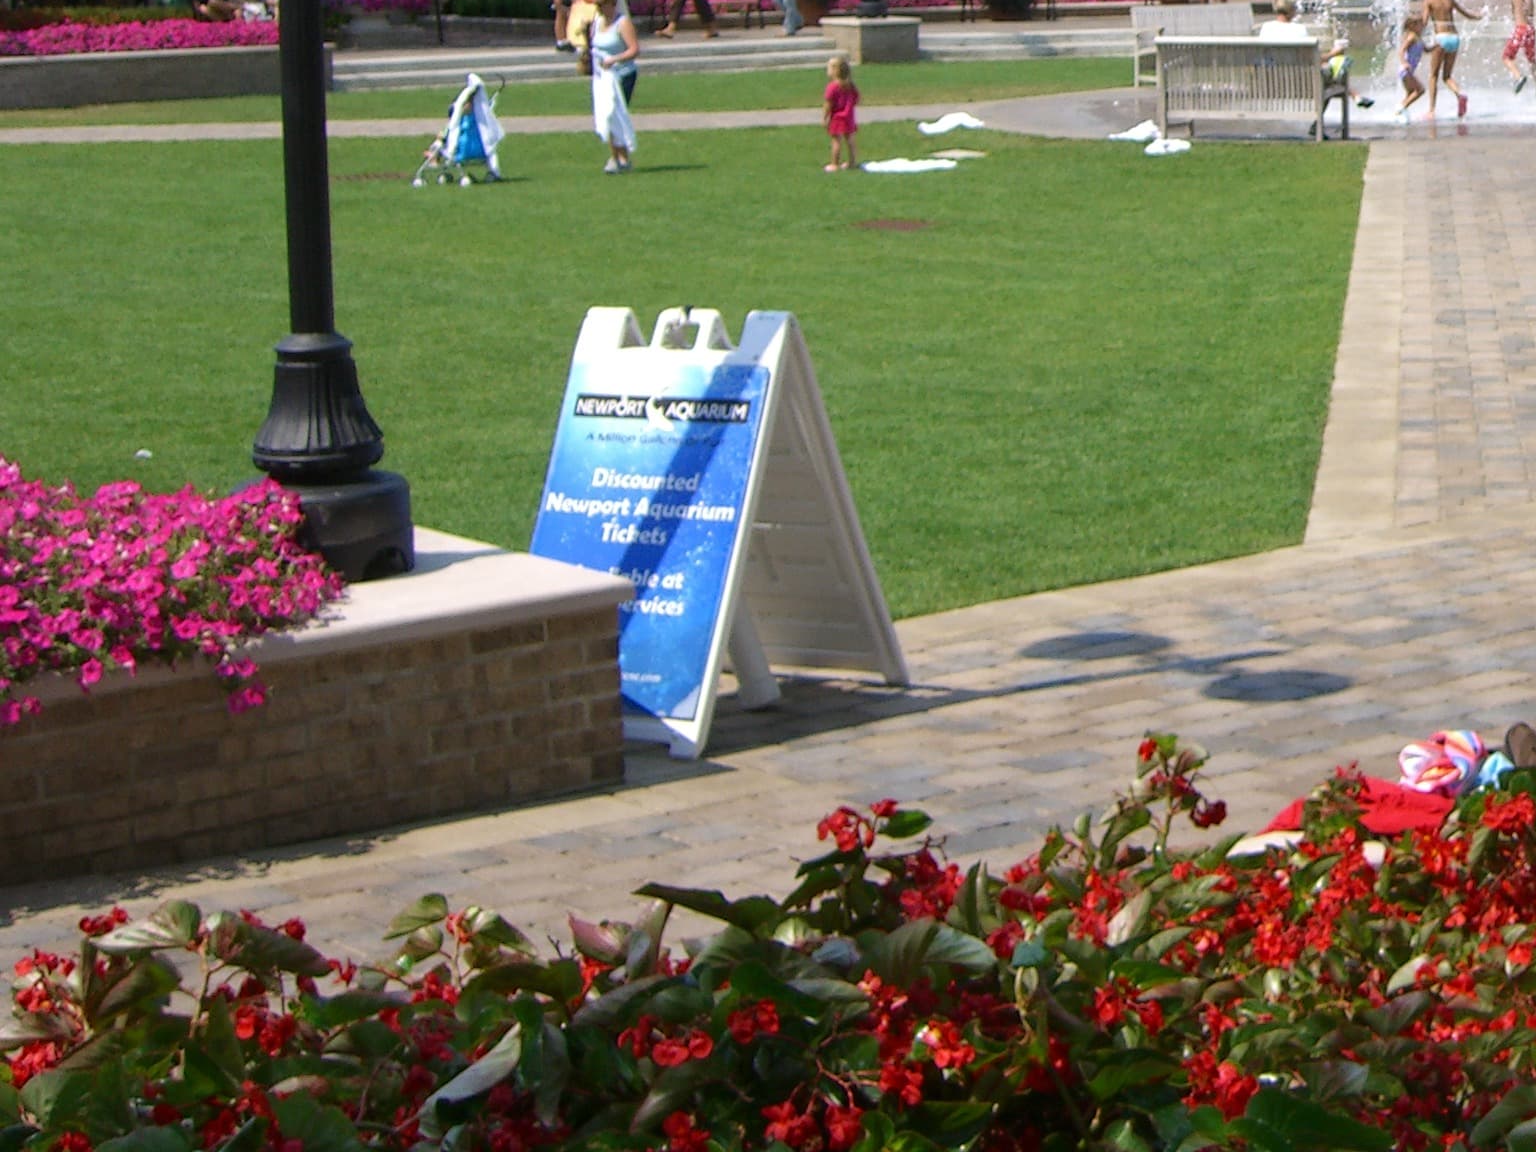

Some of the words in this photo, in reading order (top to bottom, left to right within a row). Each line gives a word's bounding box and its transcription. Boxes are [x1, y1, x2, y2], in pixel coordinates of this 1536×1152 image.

[576, 397, 644, 416] NEWPORT
[665, 401, 748, 422] AQUARIUM
[592, 466, 700, 491] Discounted
[546, 492, 630, 517] Newport
[633, 496, 736, 522] Aquarium
[601, 518, 668, 545] Tickets
[662, 572, 685, 589] at
[618, 596, 685, 617] ervices
